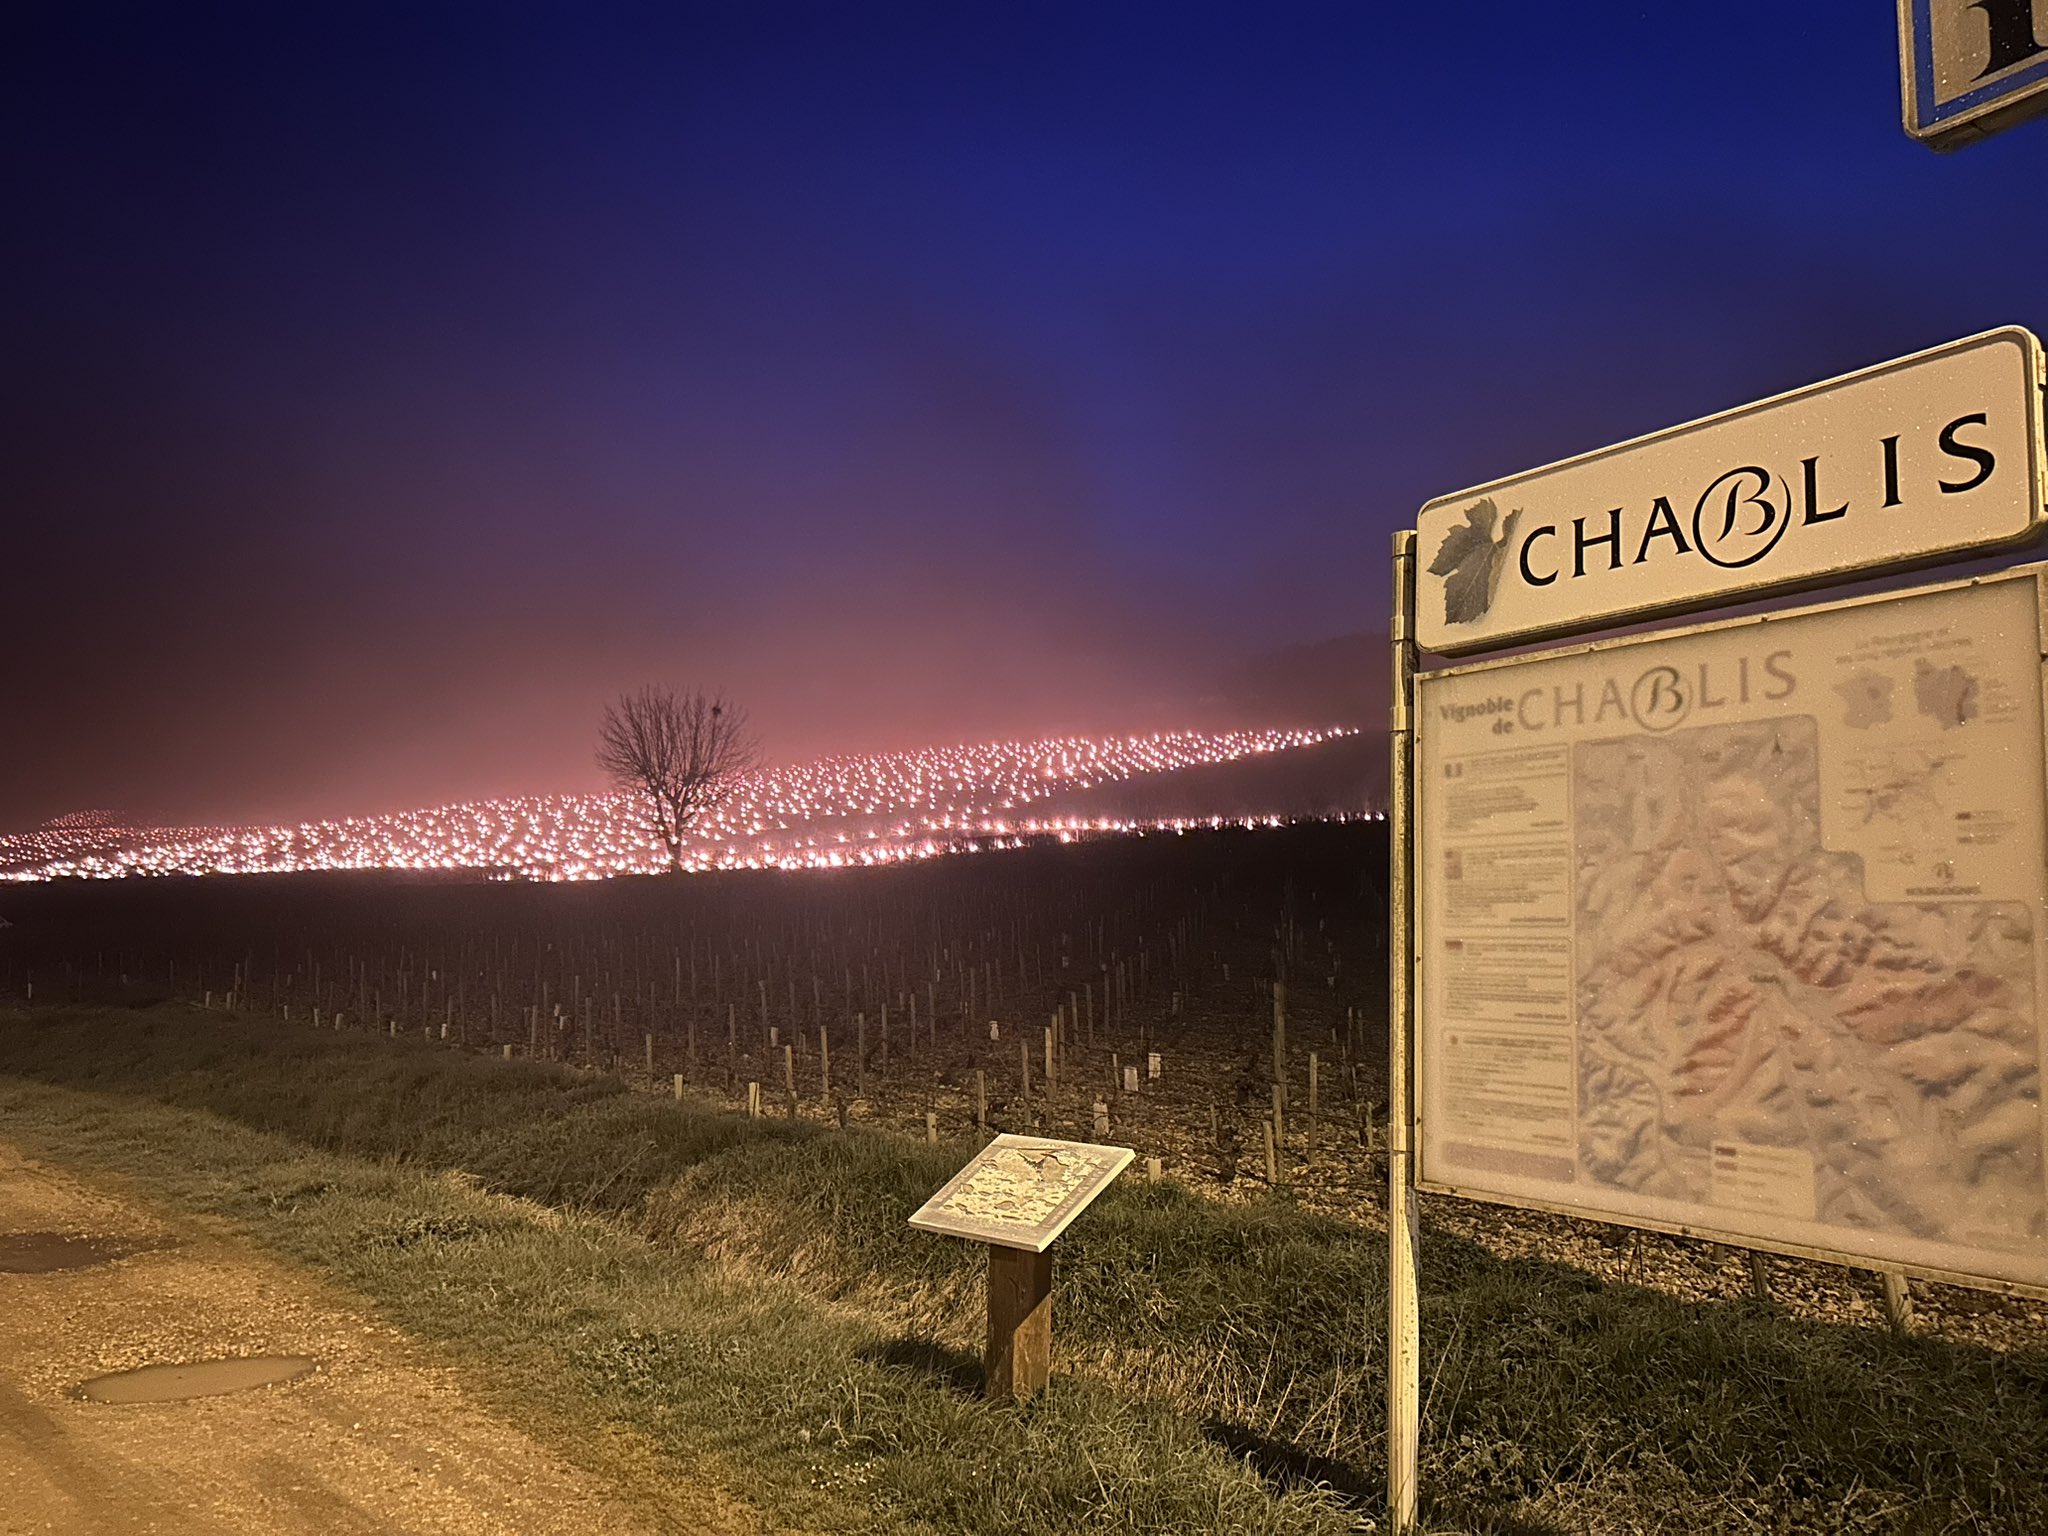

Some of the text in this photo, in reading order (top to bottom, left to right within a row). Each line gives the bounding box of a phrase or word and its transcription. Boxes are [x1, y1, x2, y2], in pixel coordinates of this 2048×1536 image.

[1519, 413, 1996, 587] CHABLIS
[1438, 696, 1514, 723] Vignoble
[1517, 650, 1797, 732] CHABLIS
[1492, 717, 1514, 735] de
